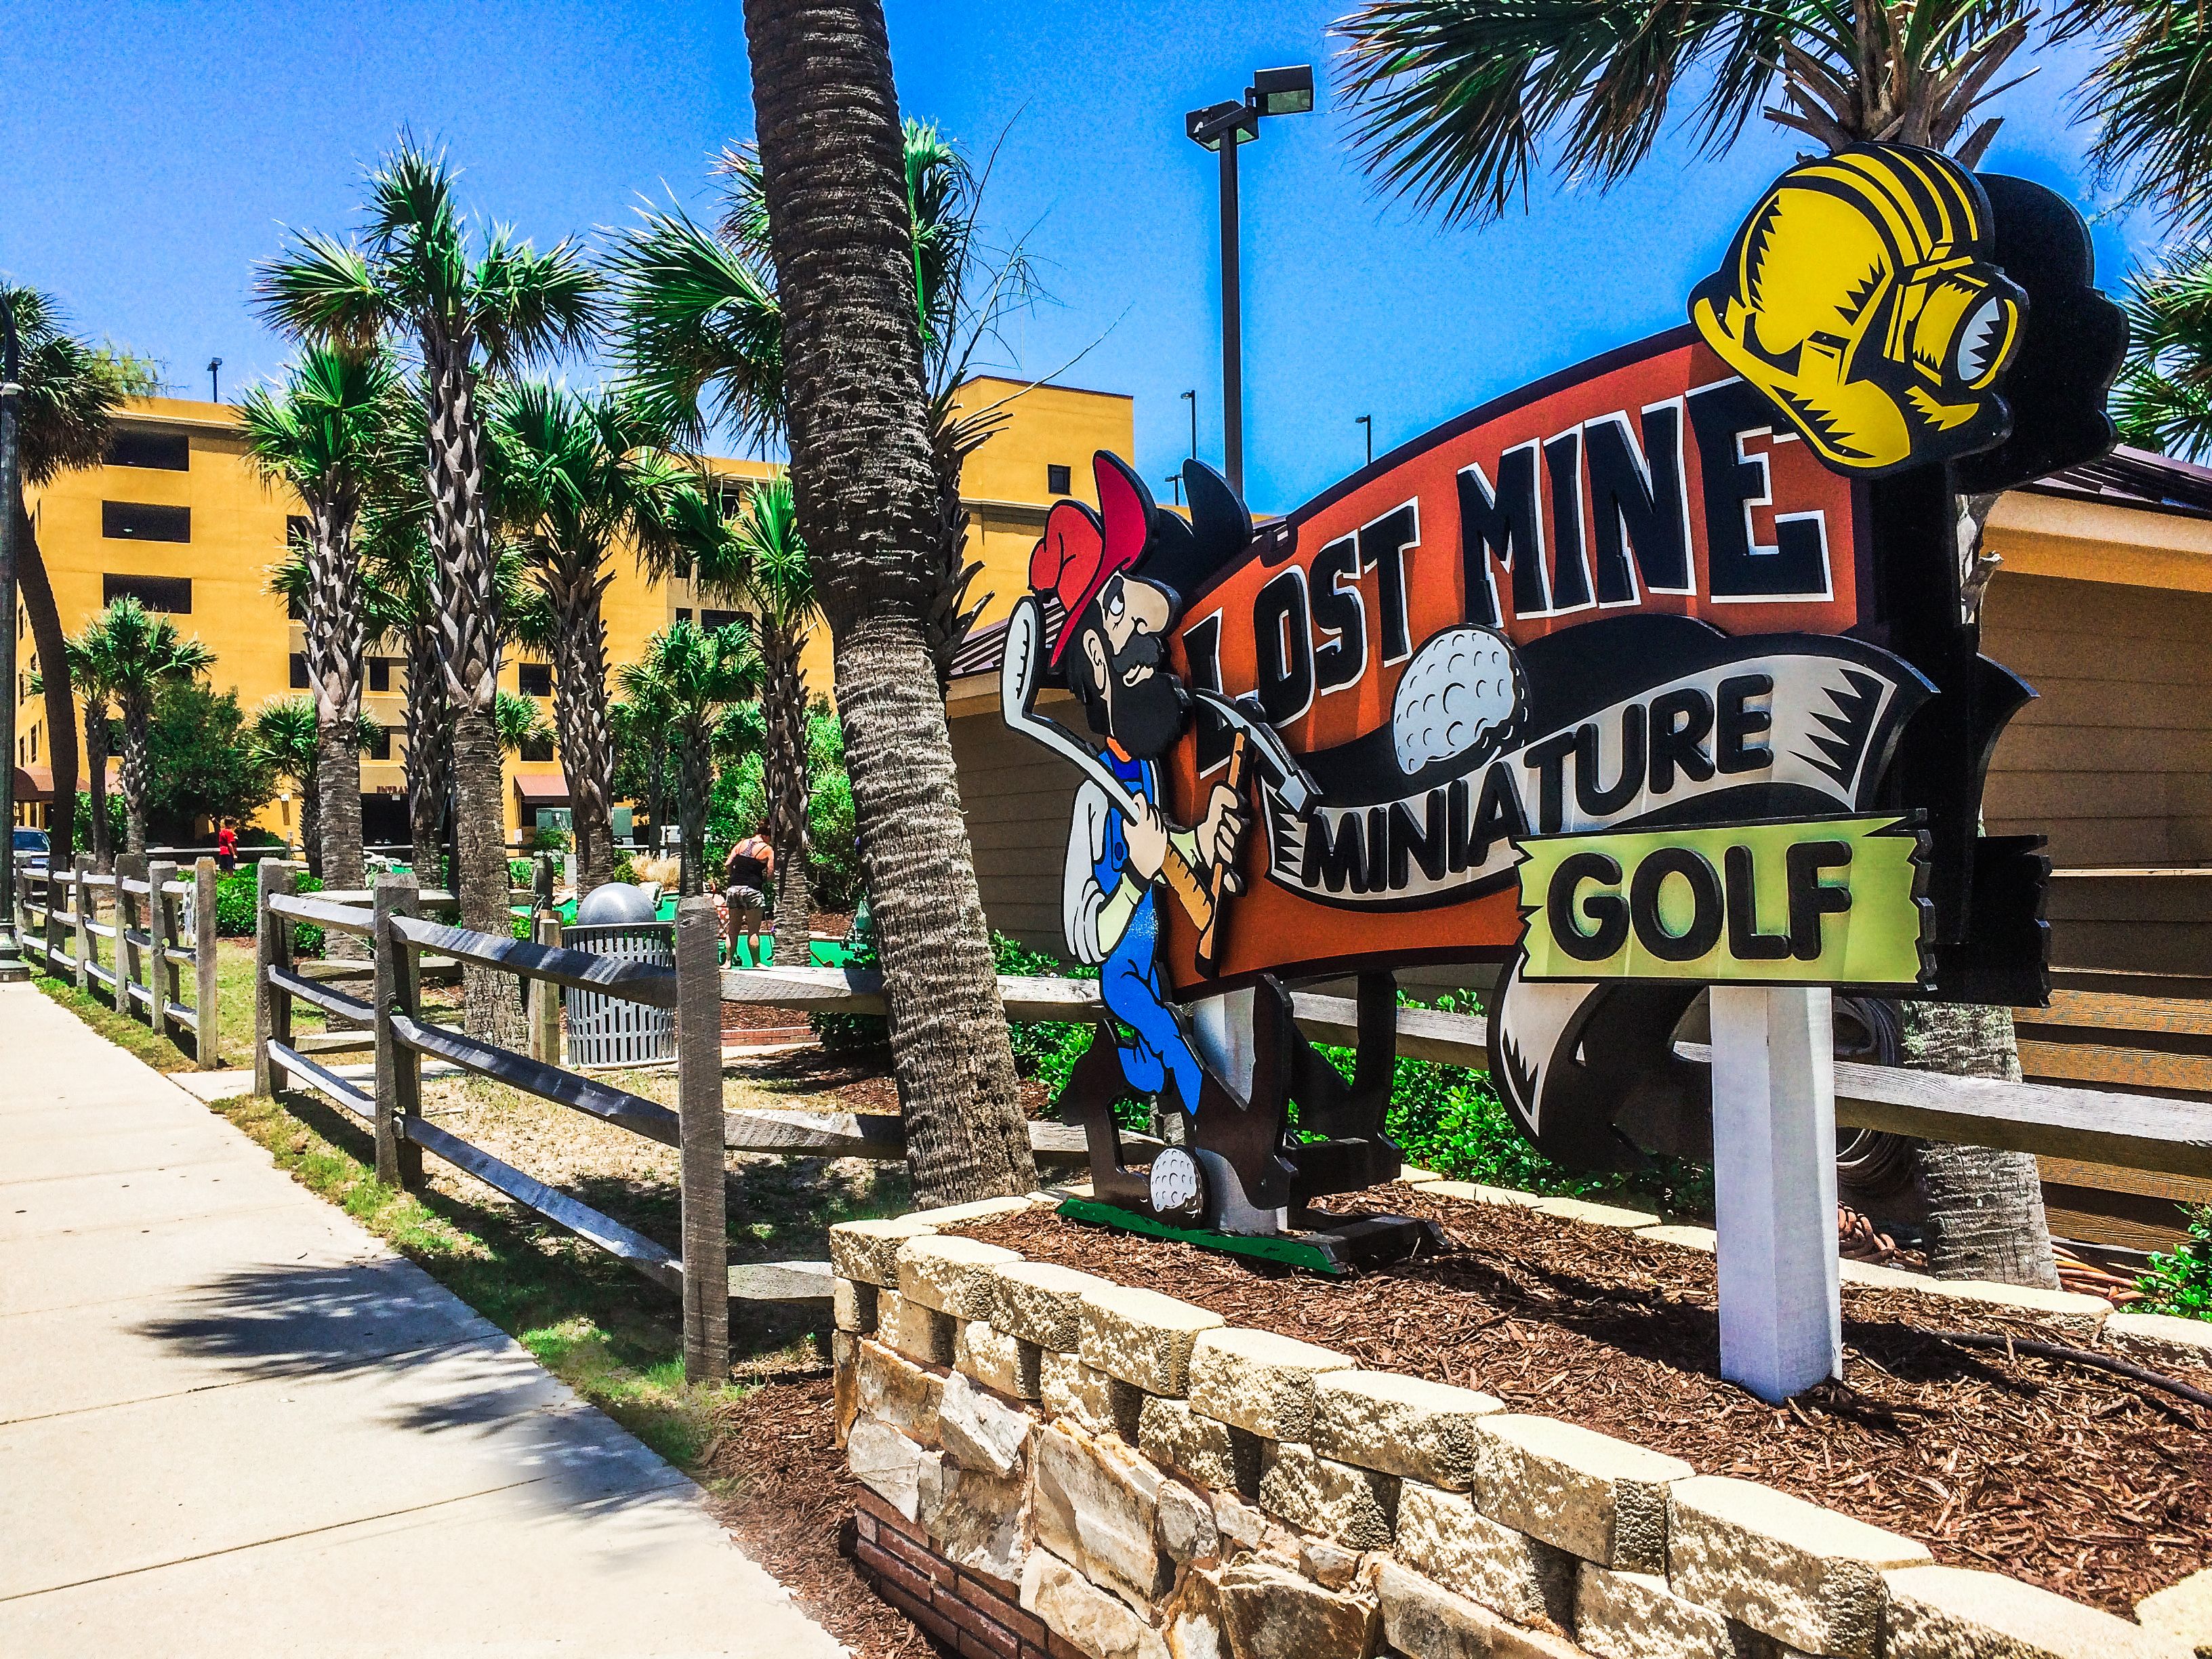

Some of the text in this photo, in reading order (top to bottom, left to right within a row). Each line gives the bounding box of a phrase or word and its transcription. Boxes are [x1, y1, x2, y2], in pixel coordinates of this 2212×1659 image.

[1183, 375, 1835, 780] LOST MINE
[1300, 674, 1774, 894] MINIATURE
[1547, 840, 1853, 961] GOLF
